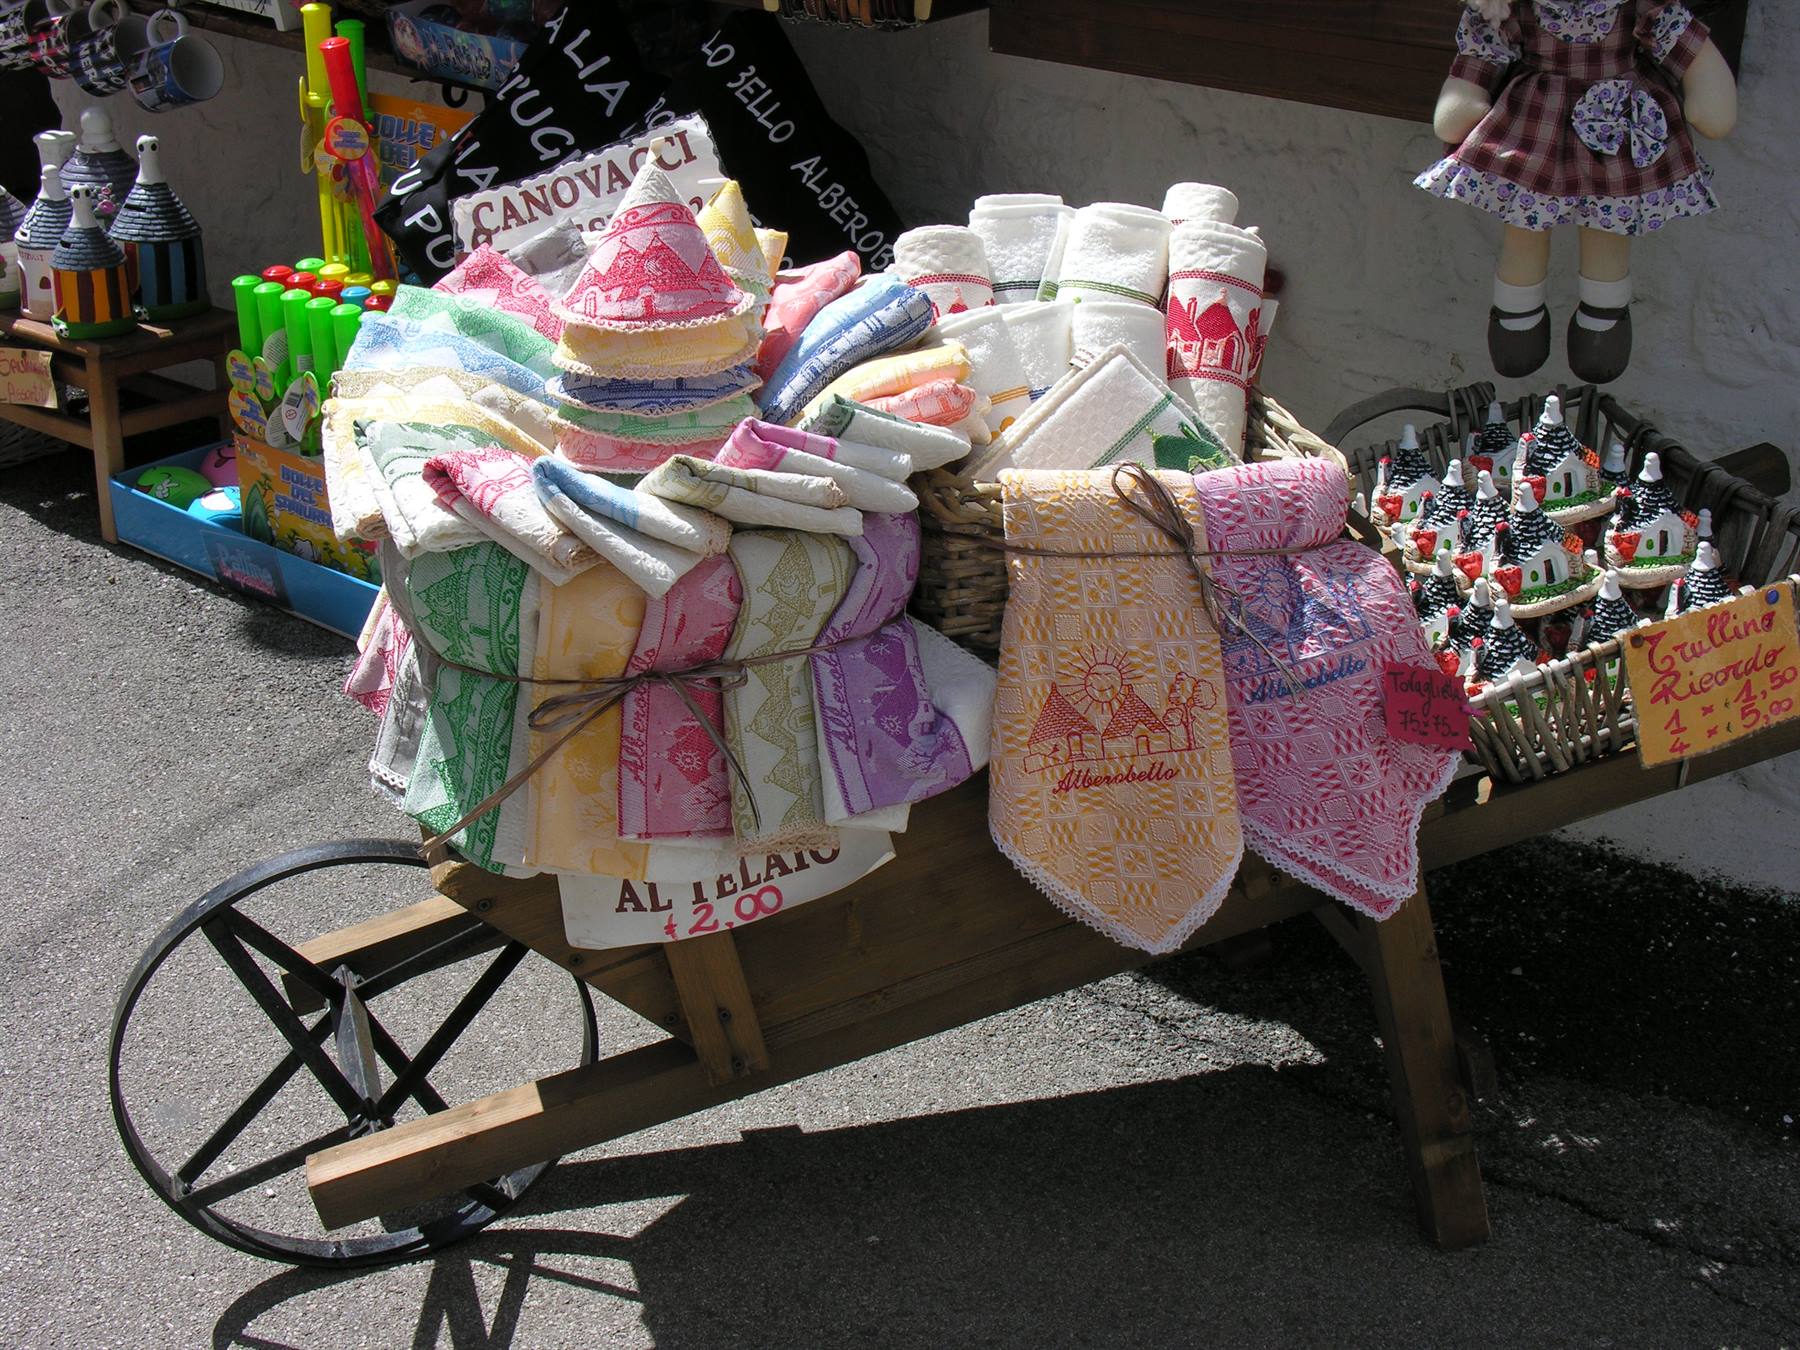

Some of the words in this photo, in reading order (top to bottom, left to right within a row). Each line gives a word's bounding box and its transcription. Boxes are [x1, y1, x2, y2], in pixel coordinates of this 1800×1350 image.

[1643, 611, 1777, 675] Trullino
[1650, 644, 1786, 705] Ricordo
[1052, 763, 1180, 795] Alberobello
